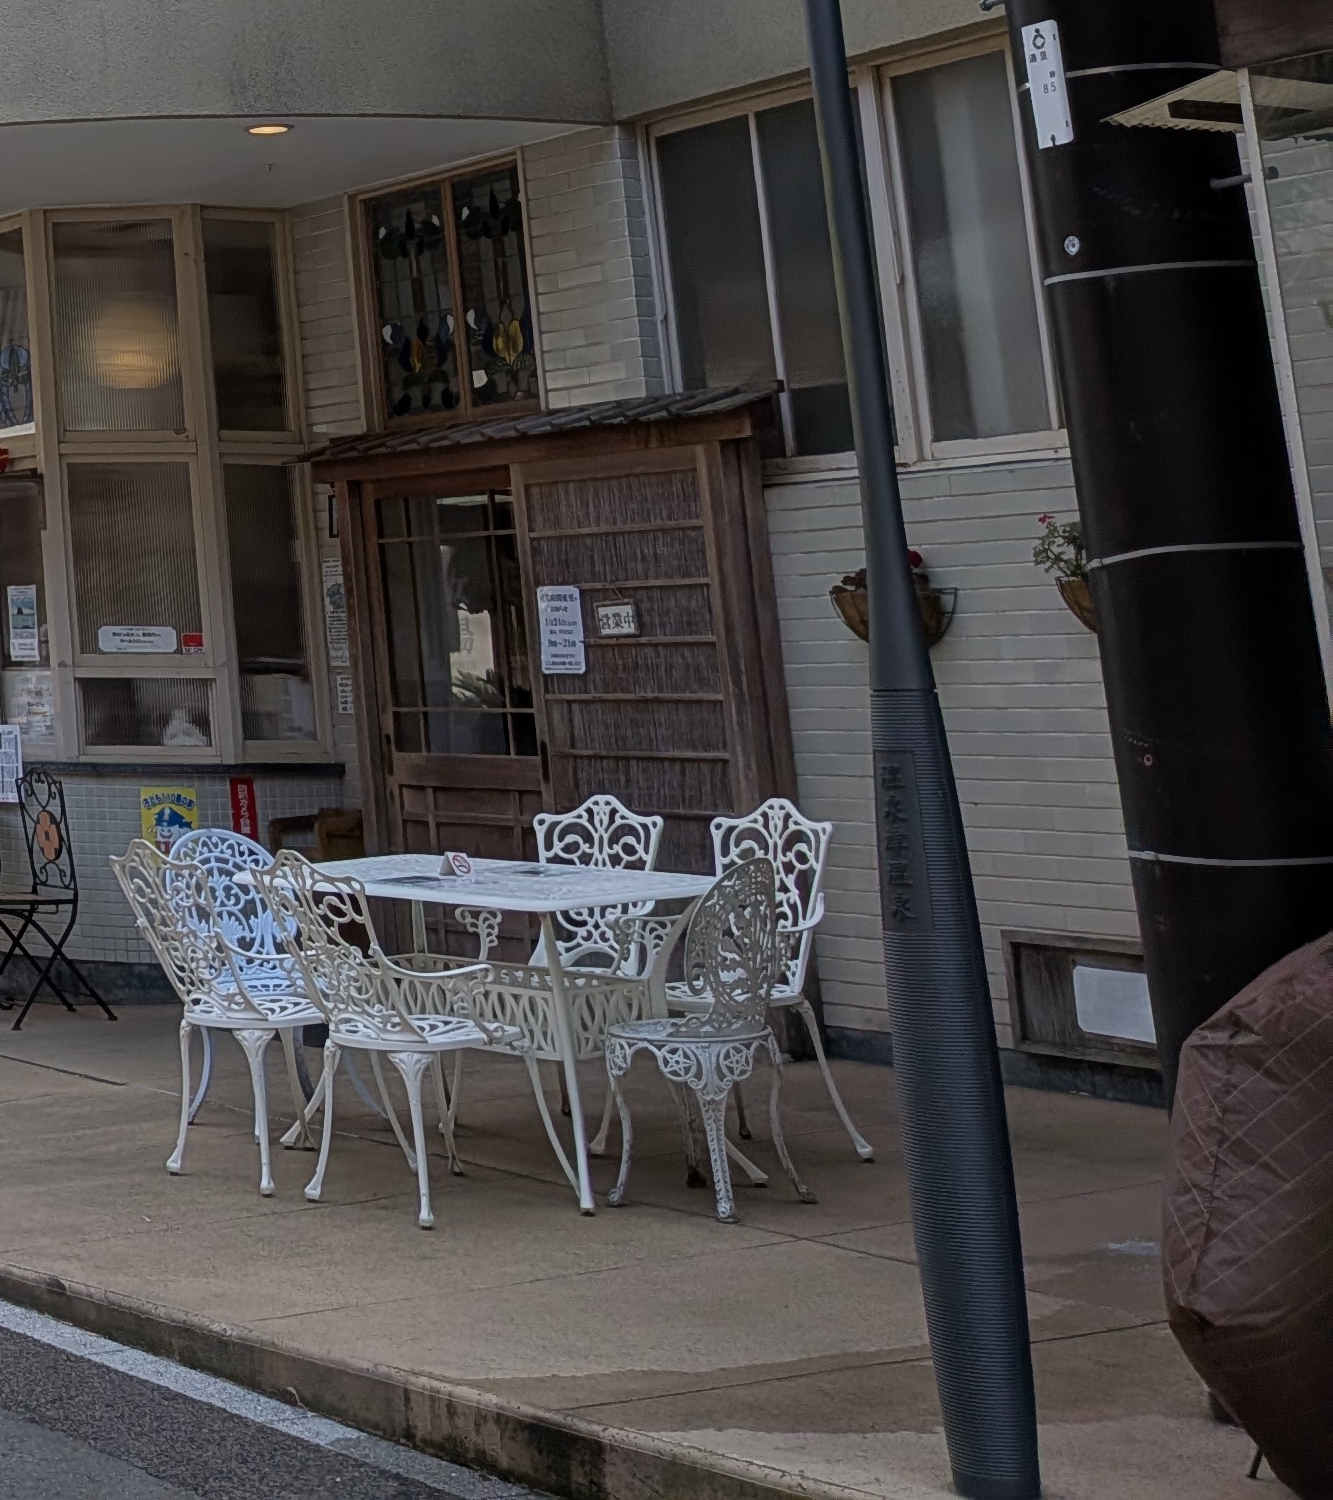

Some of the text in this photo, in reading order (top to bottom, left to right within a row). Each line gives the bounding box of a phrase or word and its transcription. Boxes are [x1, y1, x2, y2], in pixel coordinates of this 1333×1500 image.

[1043, 82, 1057, 94] 85
[600, 611, 634, 630] 営業中
